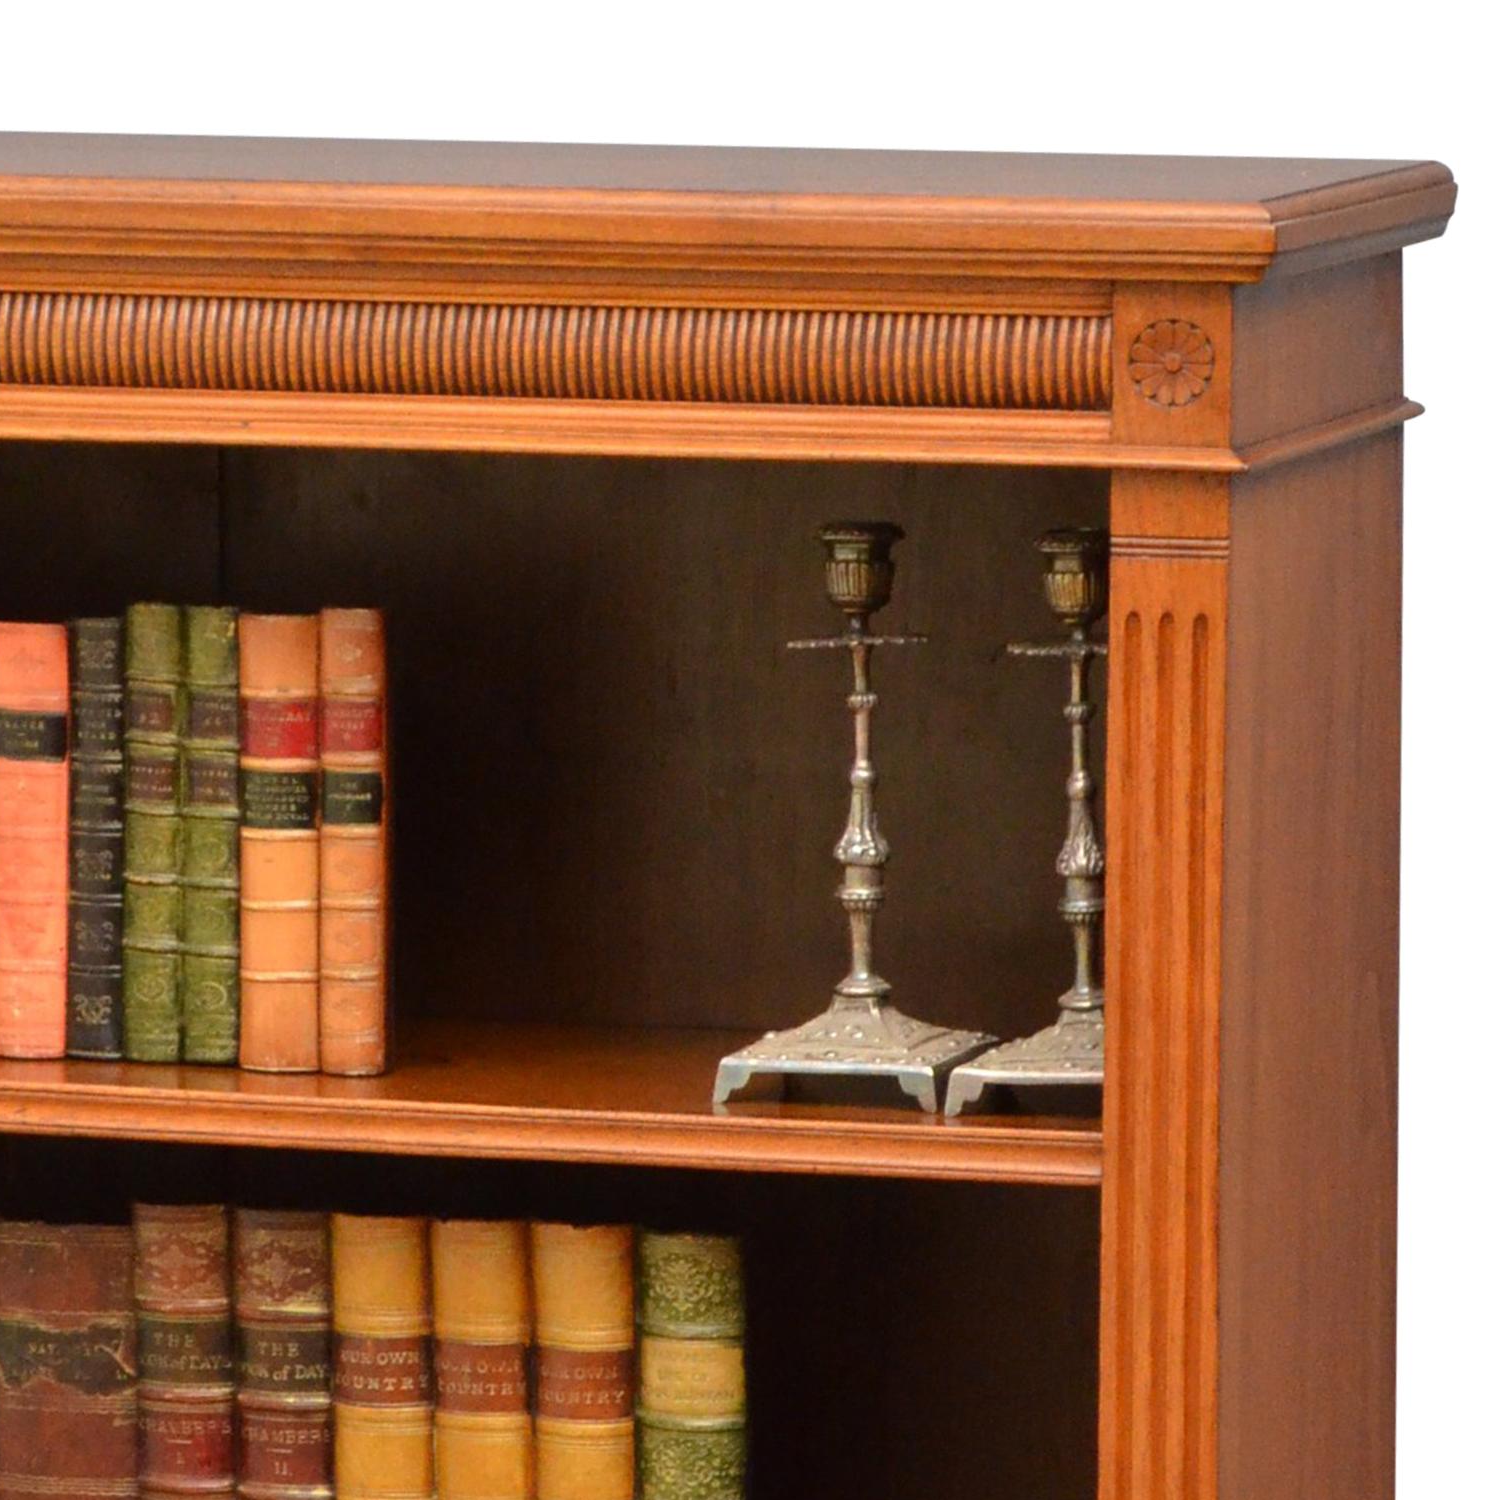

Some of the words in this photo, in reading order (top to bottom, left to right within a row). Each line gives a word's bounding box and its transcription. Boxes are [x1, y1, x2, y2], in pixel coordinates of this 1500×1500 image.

[152, 1331, 196, 1349] THE
[257, 1341, 300, 1358] THE
[376, 1350, 420, 1366] OWN
